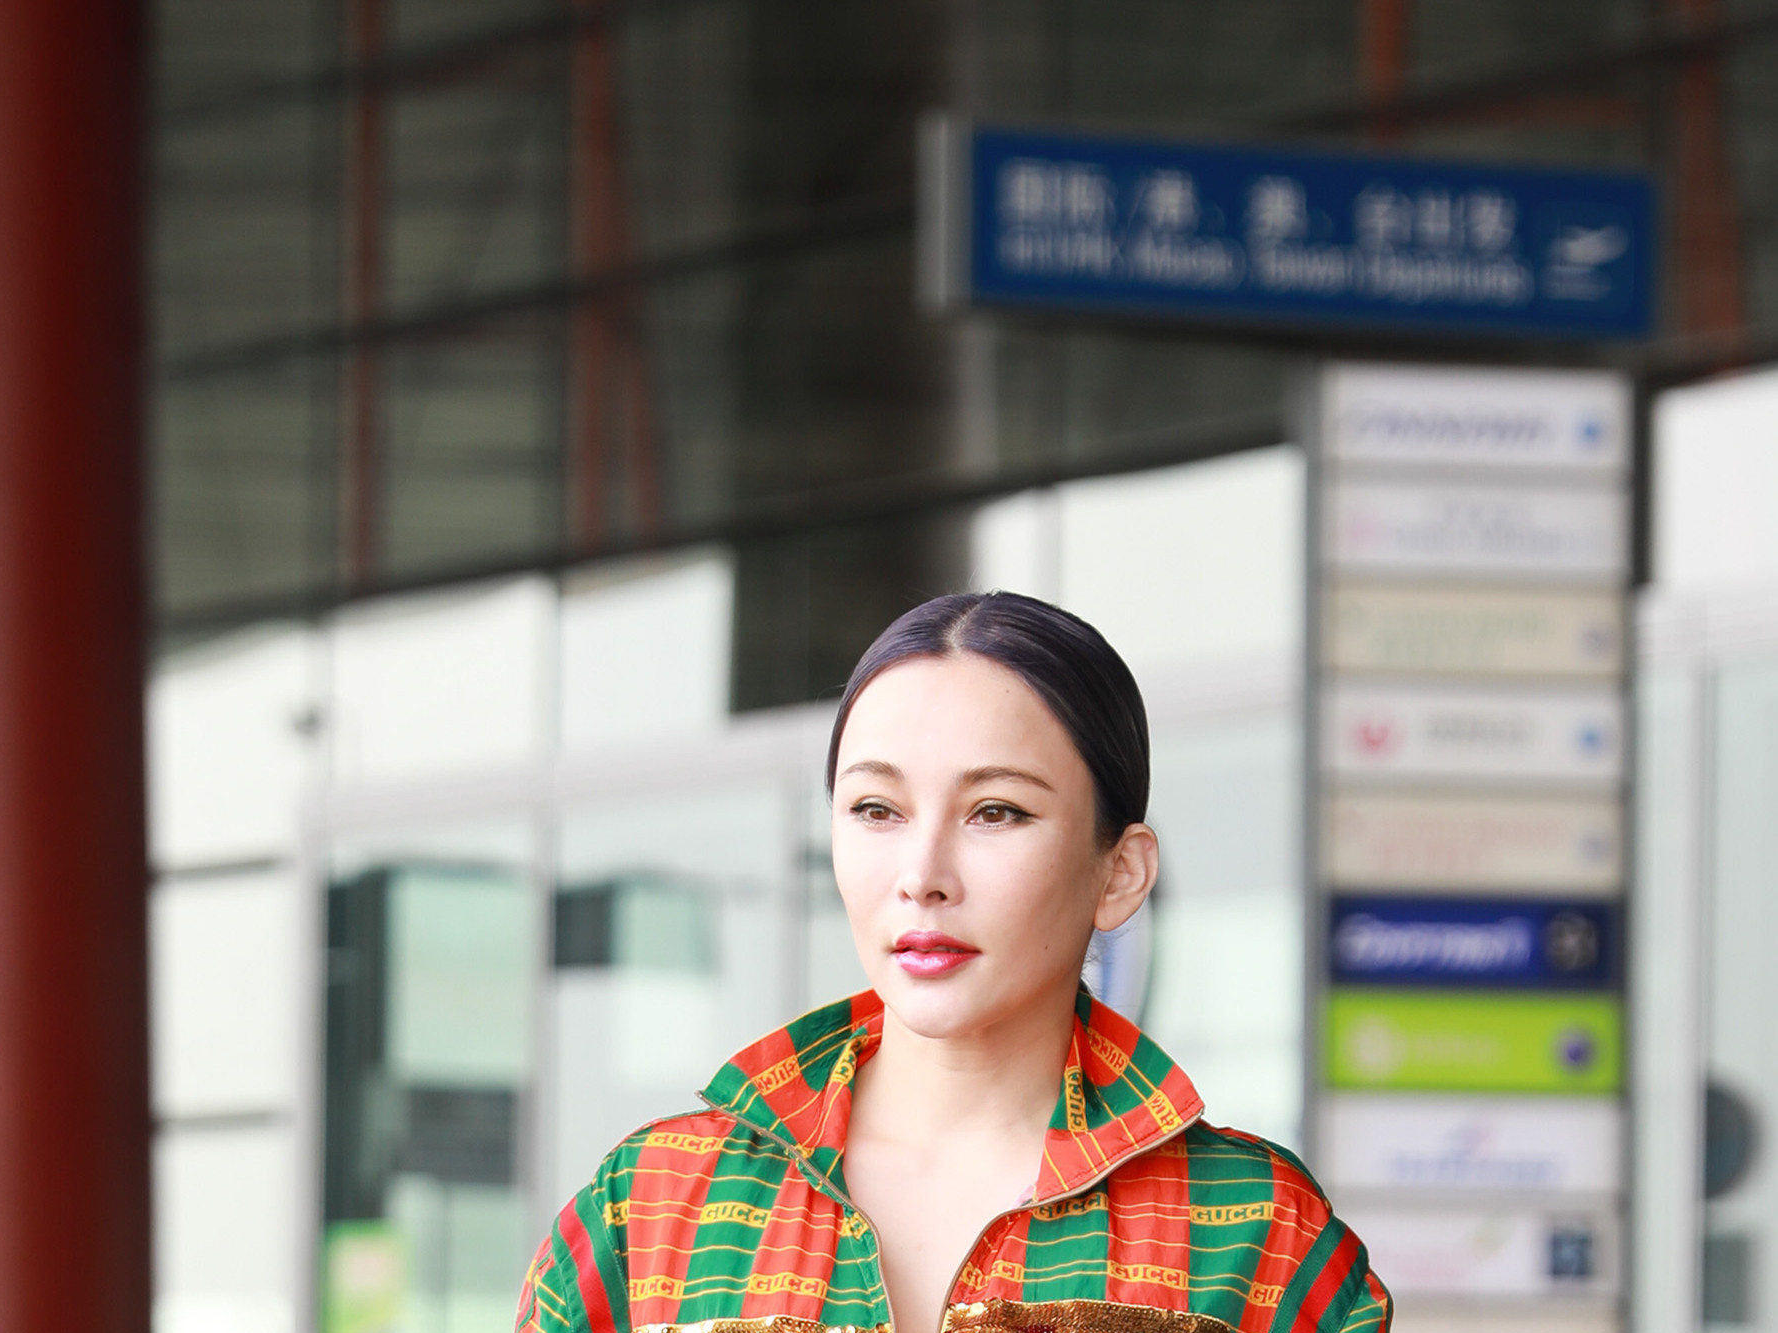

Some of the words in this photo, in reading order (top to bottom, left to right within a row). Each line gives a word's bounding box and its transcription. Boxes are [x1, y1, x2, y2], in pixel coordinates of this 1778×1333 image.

[703, 1203, 771, 1227] GUCCI
[1193, 1203, 1273, 1224] GUCCI
[750, 1274, 827, 1298] GUCCI
[1109, 1265, 1187, 1289] GUCCI
